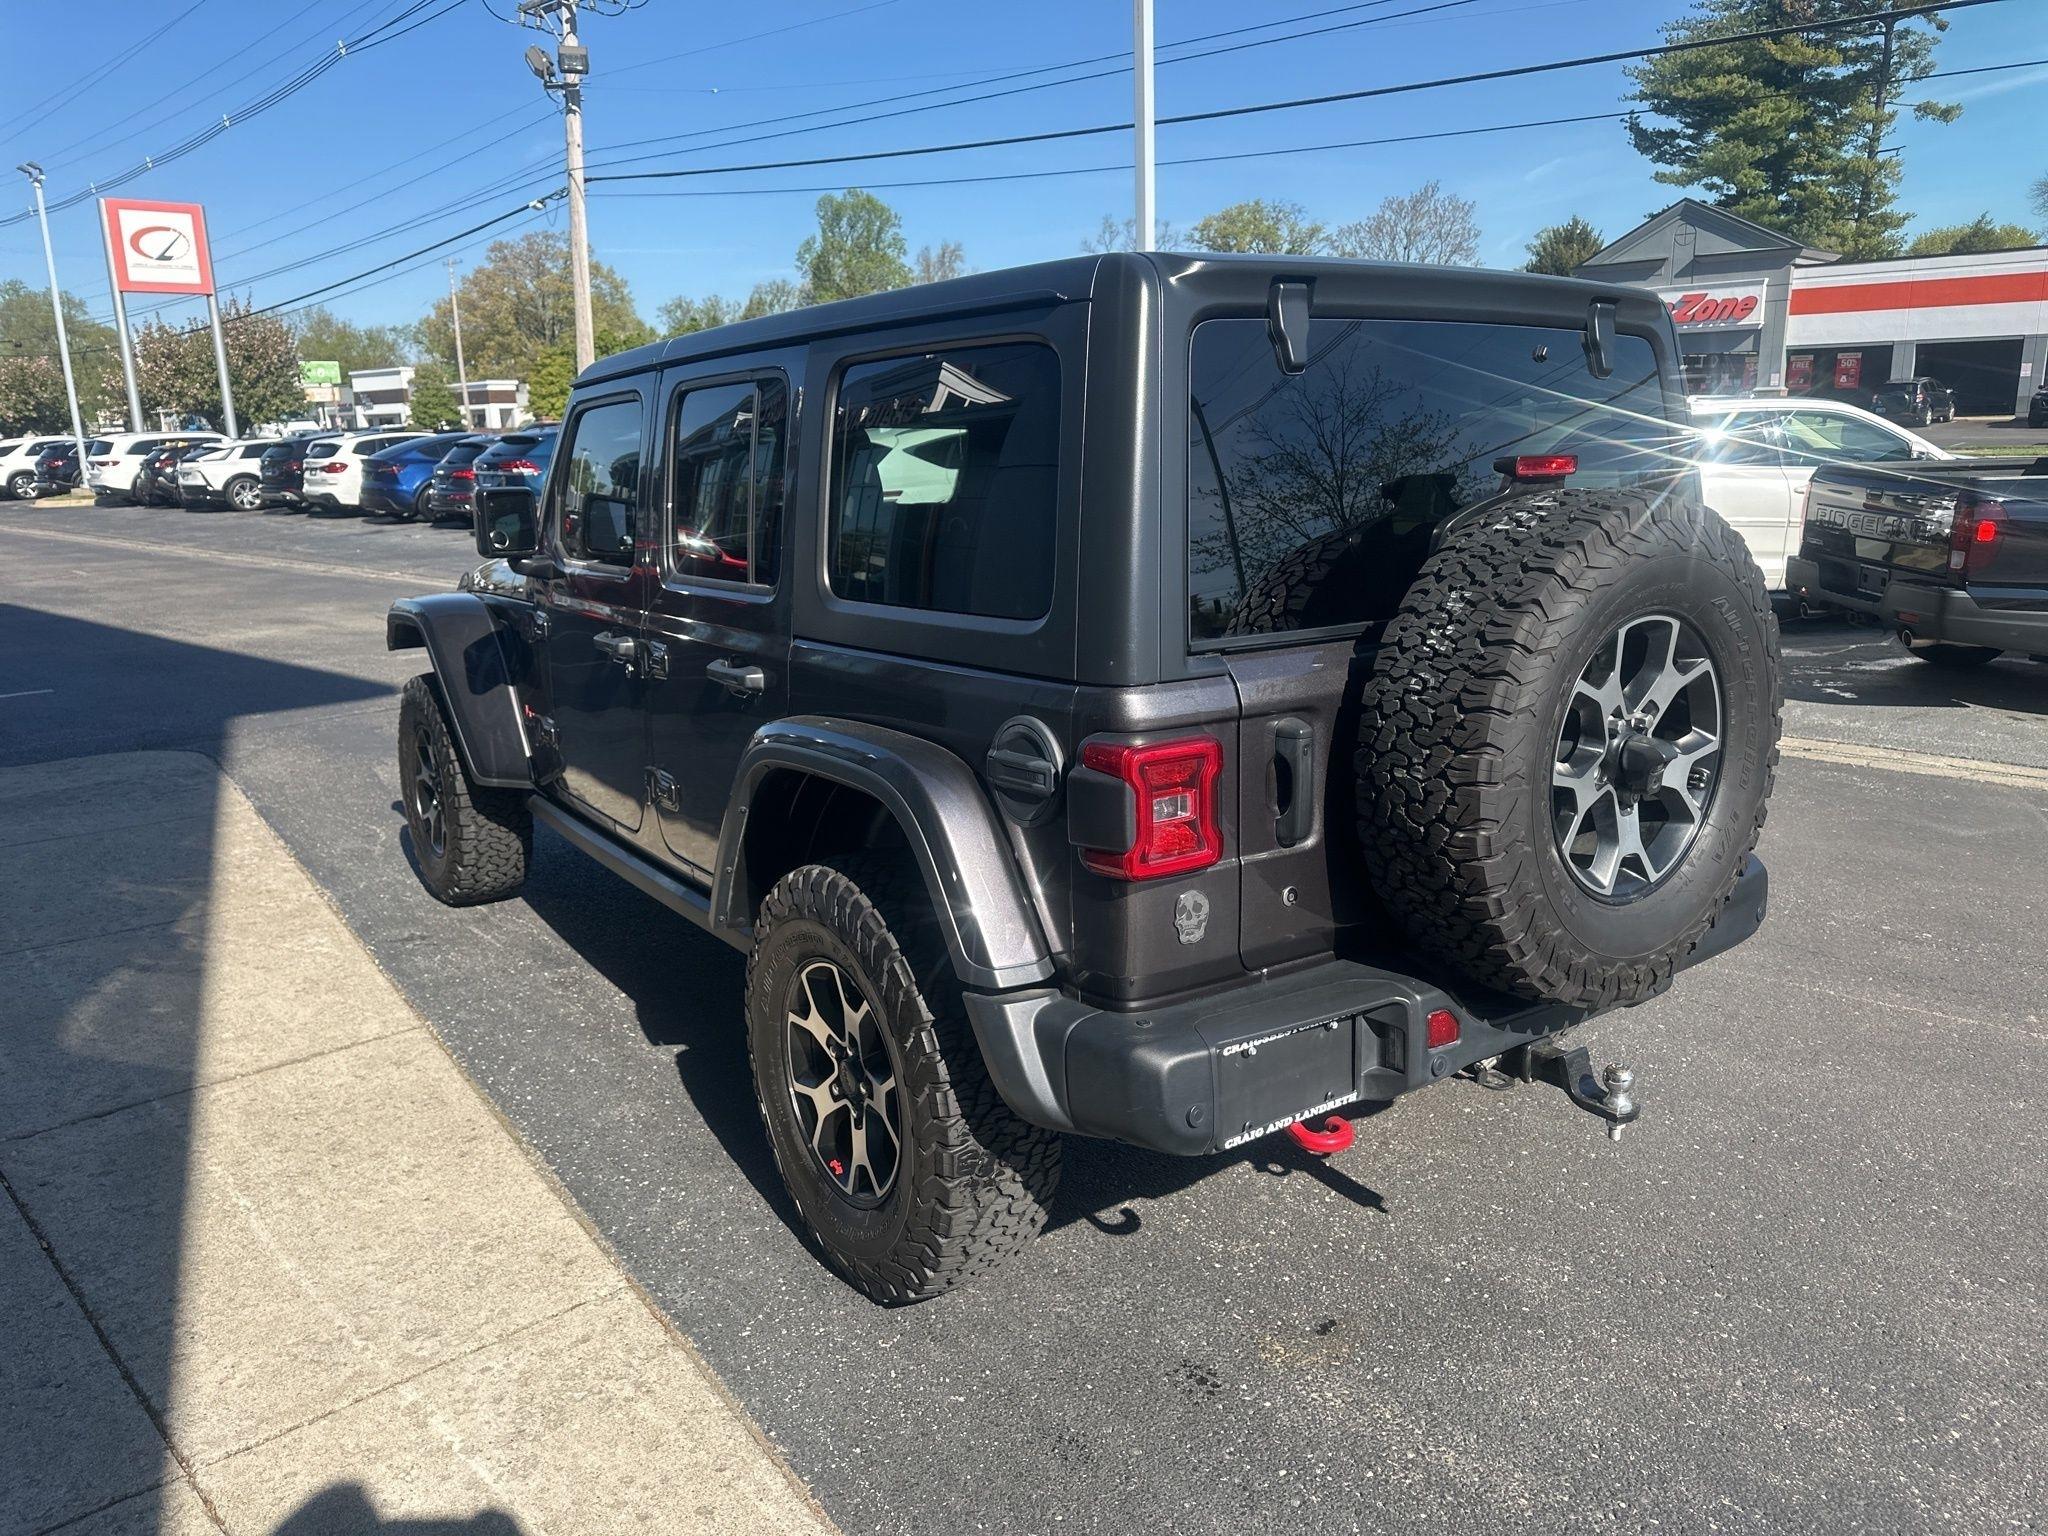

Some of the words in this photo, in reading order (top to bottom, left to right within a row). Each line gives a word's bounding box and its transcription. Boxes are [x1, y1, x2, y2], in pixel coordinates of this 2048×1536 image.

[1224, 1127, 1264, 1149] CRAIG
[1265, 1116, 1293, 1133] AND
[1294, 1090, 1357, 1123] LANDRETH
